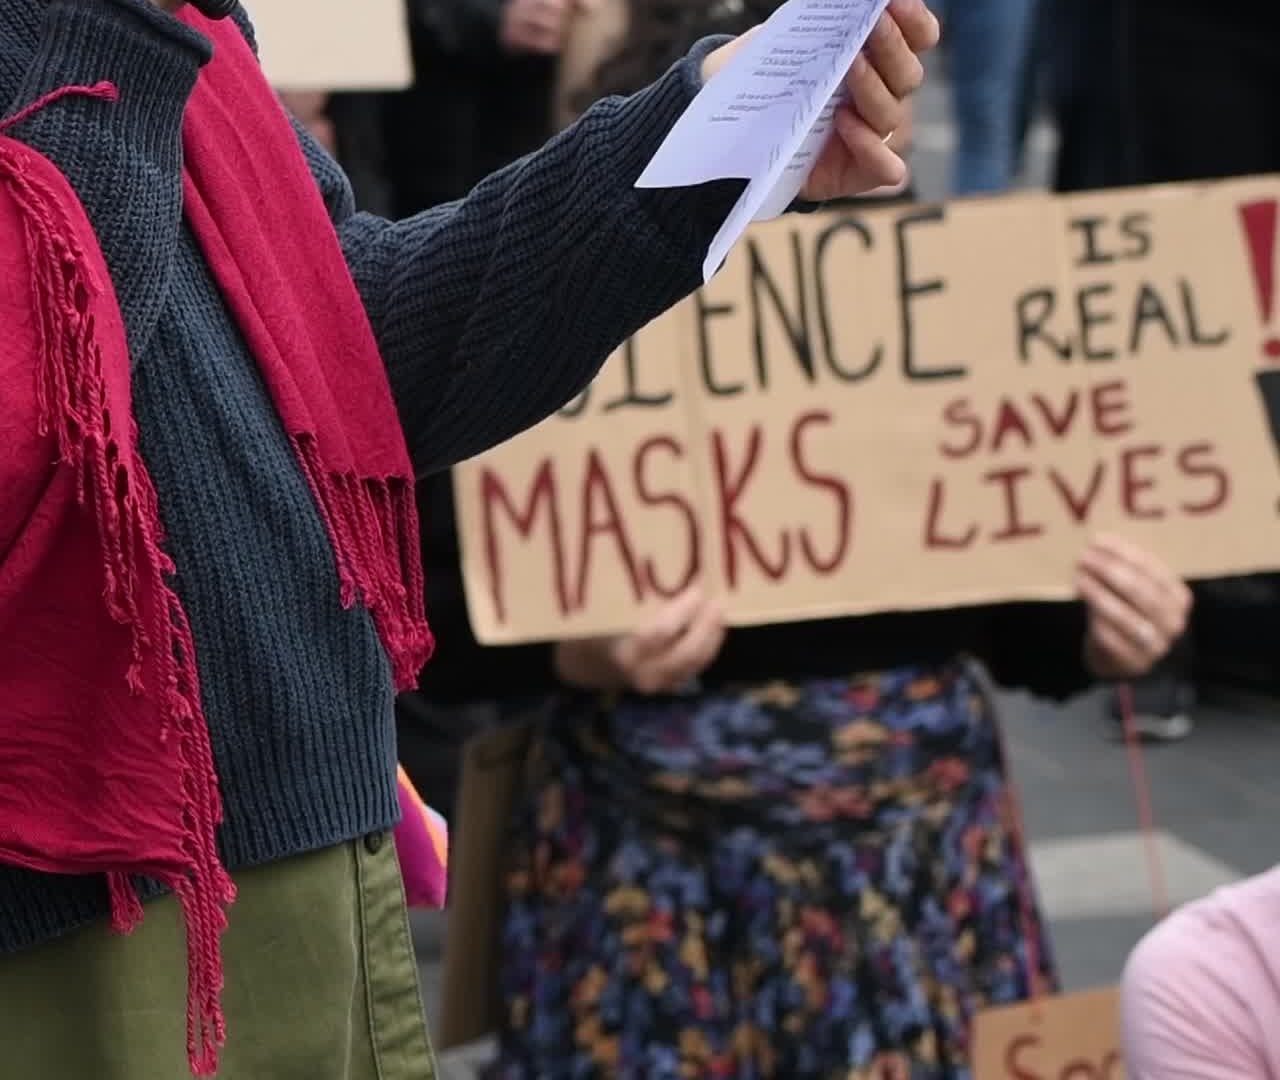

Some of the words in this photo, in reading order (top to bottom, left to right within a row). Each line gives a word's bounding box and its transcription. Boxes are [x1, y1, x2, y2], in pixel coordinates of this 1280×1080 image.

[1068, 211, 1154, 267] IS
[1014, 277, 1229, 365] REAL
[940, 378, 1135, 462] SAVE
[479, 406, 856, 626] MASKS
[923, 442, 1234, 551] LIVES
